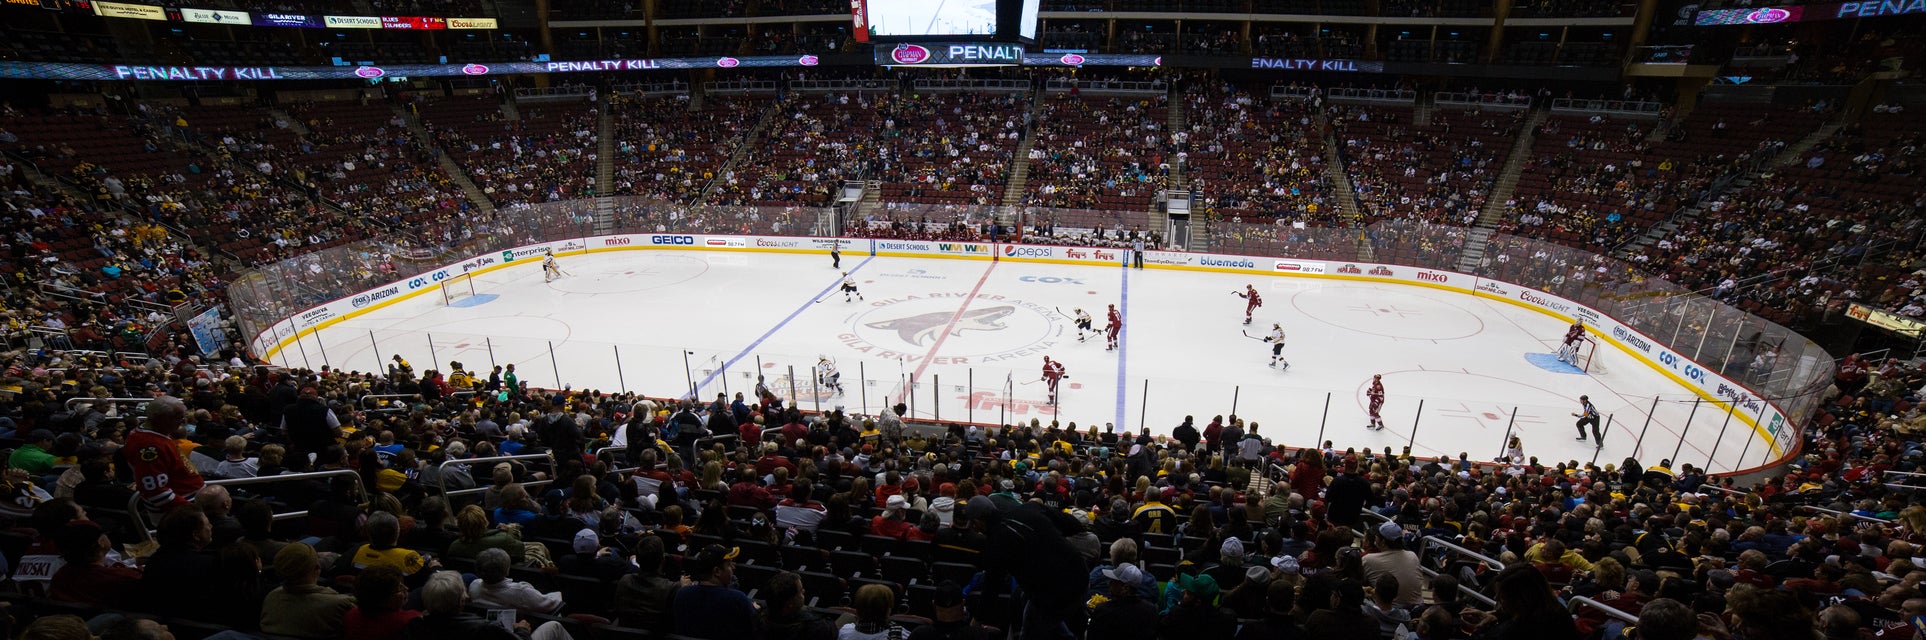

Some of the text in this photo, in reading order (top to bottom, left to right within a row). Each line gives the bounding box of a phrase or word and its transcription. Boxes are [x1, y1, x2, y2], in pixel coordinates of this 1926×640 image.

[336, 17, 356, 25] DESERT
[451, 20, 472, 28] Coors
[949, 46, 1024, 60] PENALTY
[548, 59, 660, 72] PENALTY KILL
[1321, 60, 1358, 72] KILL
[115, 66, 283, 80] PENALTY KILL
[652, 236, 694, 245] GEICO
[756, 238, 778, 247] Coors
[886, 242, 930, 251] DESERT SCHOOLS
[939, 243, 988, 253] WM WM
[1017, 247, 1052, 258] pepsi
[1066, 248, 1114, 261] fry's fry's
[1200, 256, 1253, 268] bluemedia
[408, 270, 451, 289] COX COX
[1018, 276, 1085, 286] COX
[355, 286, 399, 304] FOX ARIZONA
[1520, 289, 1570, 314] Coors LIGHT
[871, 292, 1064, 323] GILA RIVER ARENA
[1849, 305, 1869, 321] fry's
[1616, 326, 1651, 353] FOX ARIZONA
[837, 332, 1057, 365] GILA RIVER ARENA
[1659, 350, 1706, 385] COX COX
[142, 473, 170, 491] 88
[1148, 510, 1162, 518] ORR
[1148, 519, 1161, 534] 4
